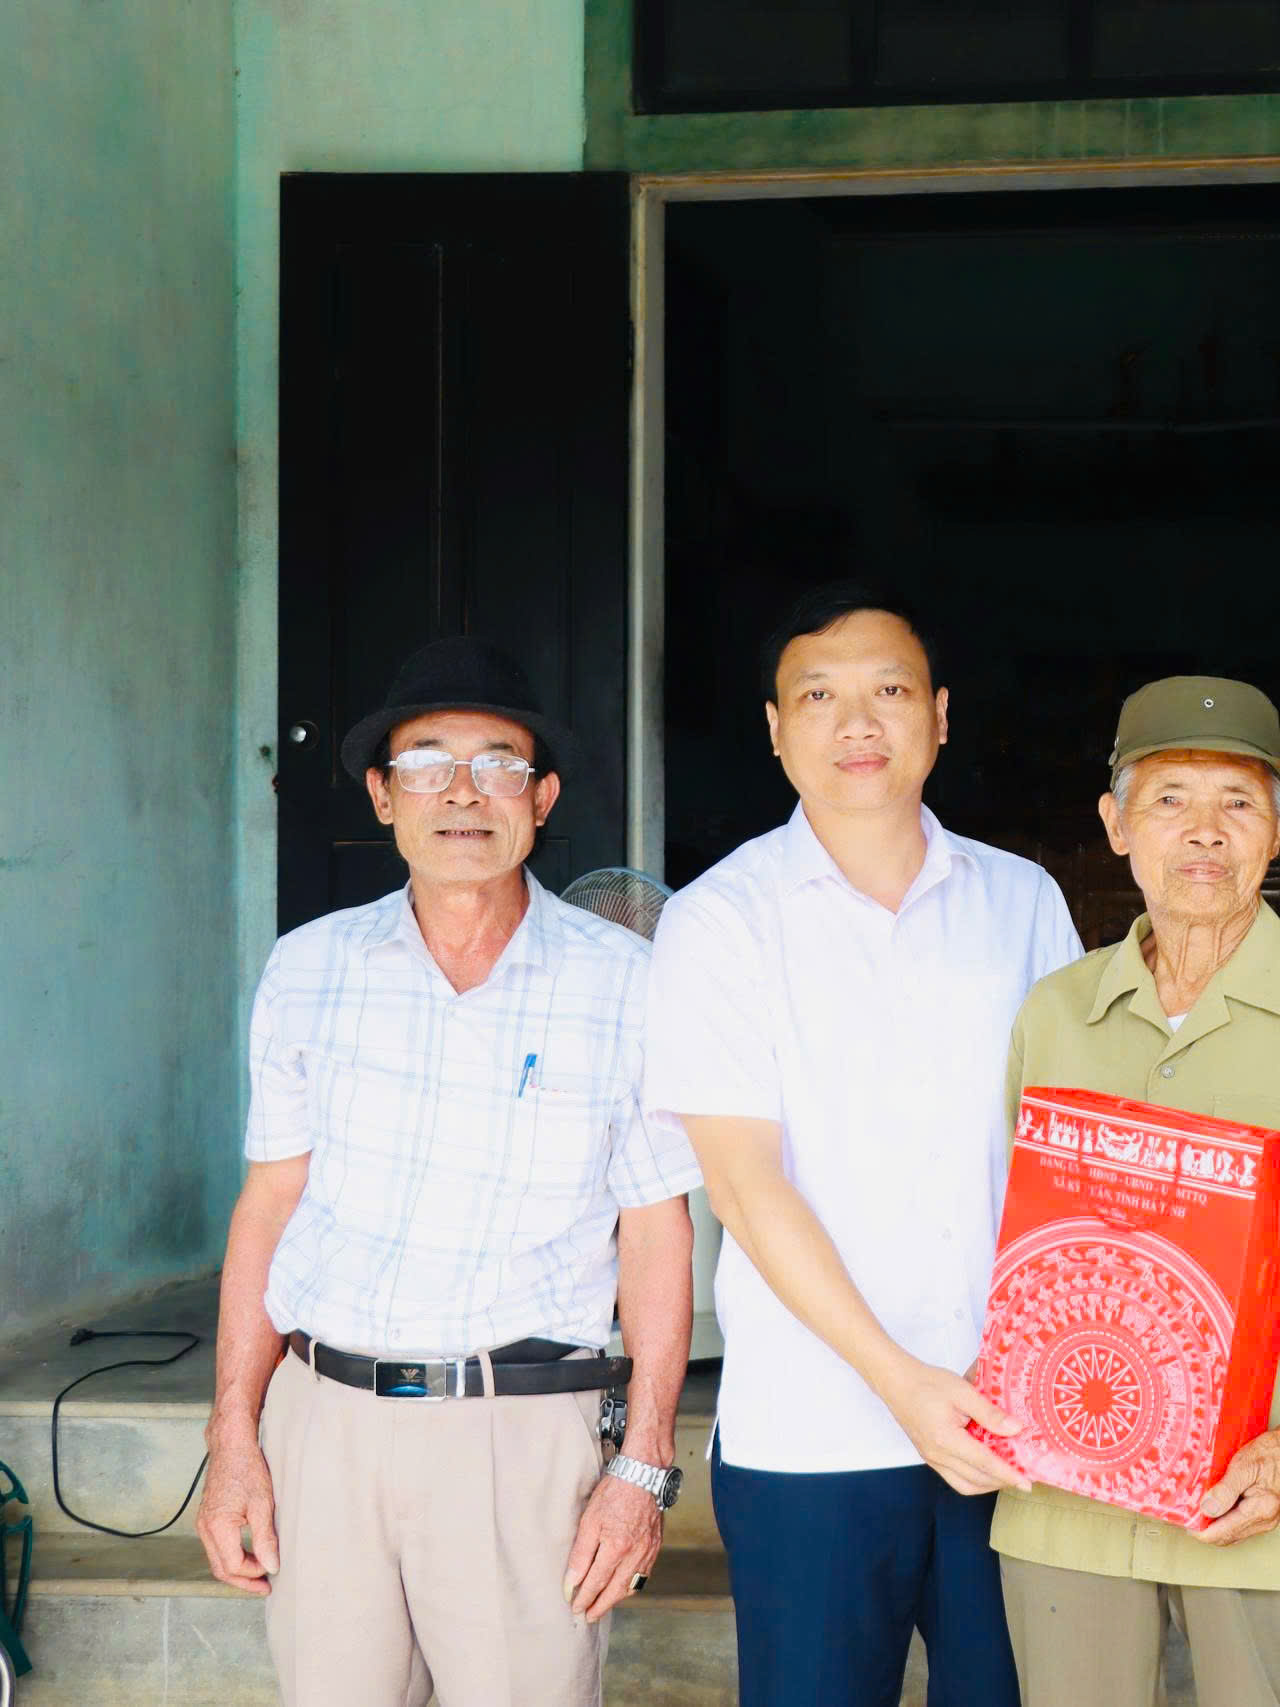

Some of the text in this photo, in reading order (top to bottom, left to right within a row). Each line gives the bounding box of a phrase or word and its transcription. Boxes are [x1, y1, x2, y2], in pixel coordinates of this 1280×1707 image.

[1125, 1175, 1153, 1192] UBND
[1161, 1184, 1208, 1207] UMTTQ
[1159, 1201, 1186, 1218] TNH
